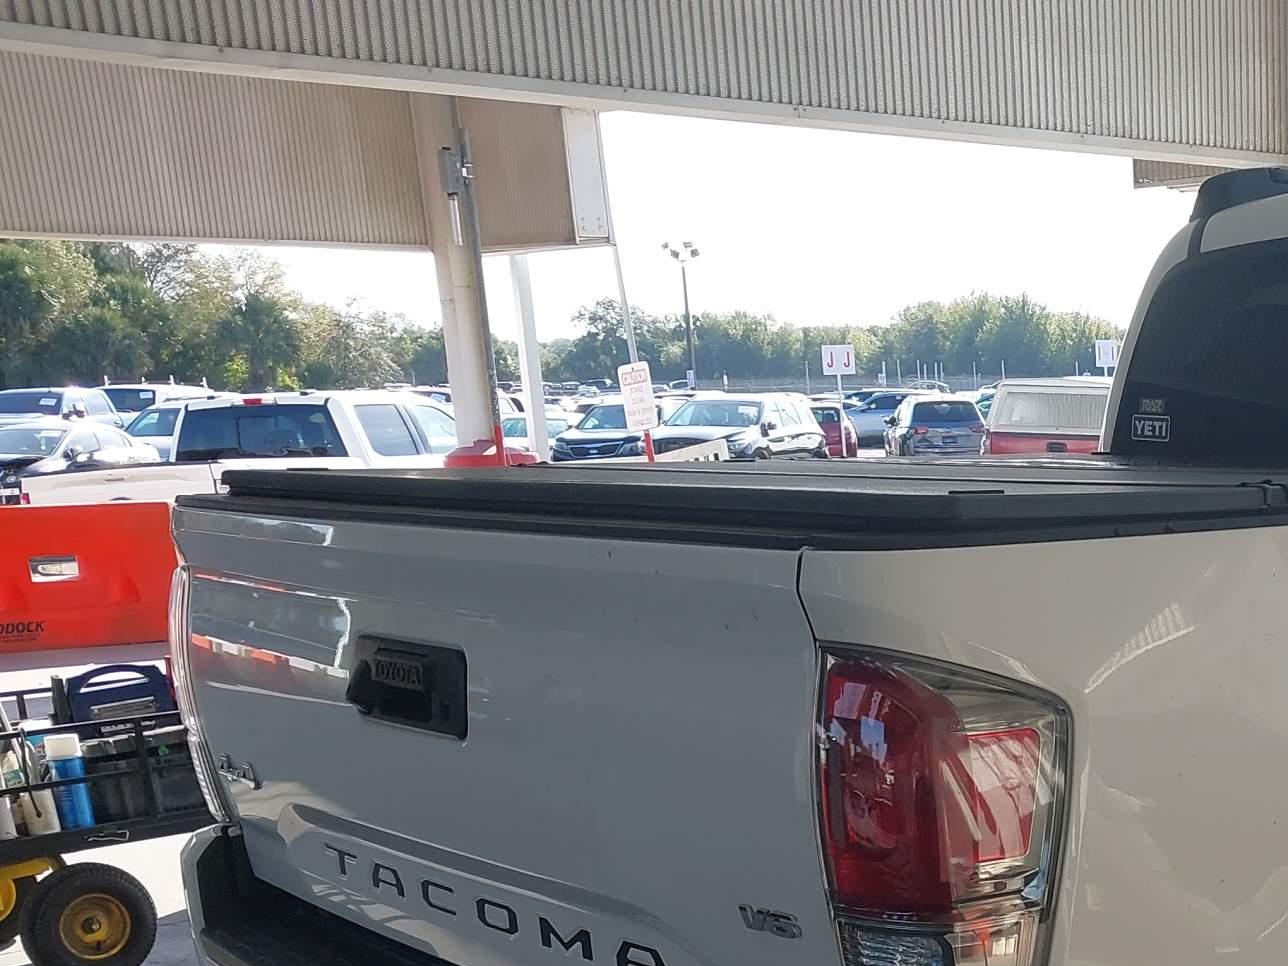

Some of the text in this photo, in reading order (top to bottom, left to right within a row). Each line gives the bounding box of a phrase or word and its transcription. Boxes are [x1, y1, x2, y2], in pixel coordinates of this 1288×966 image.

[1134, 420, 1167, 437] YETI
[373, 659, 423, 687] TOYOTA
[738, 903, 803, 940] V6
